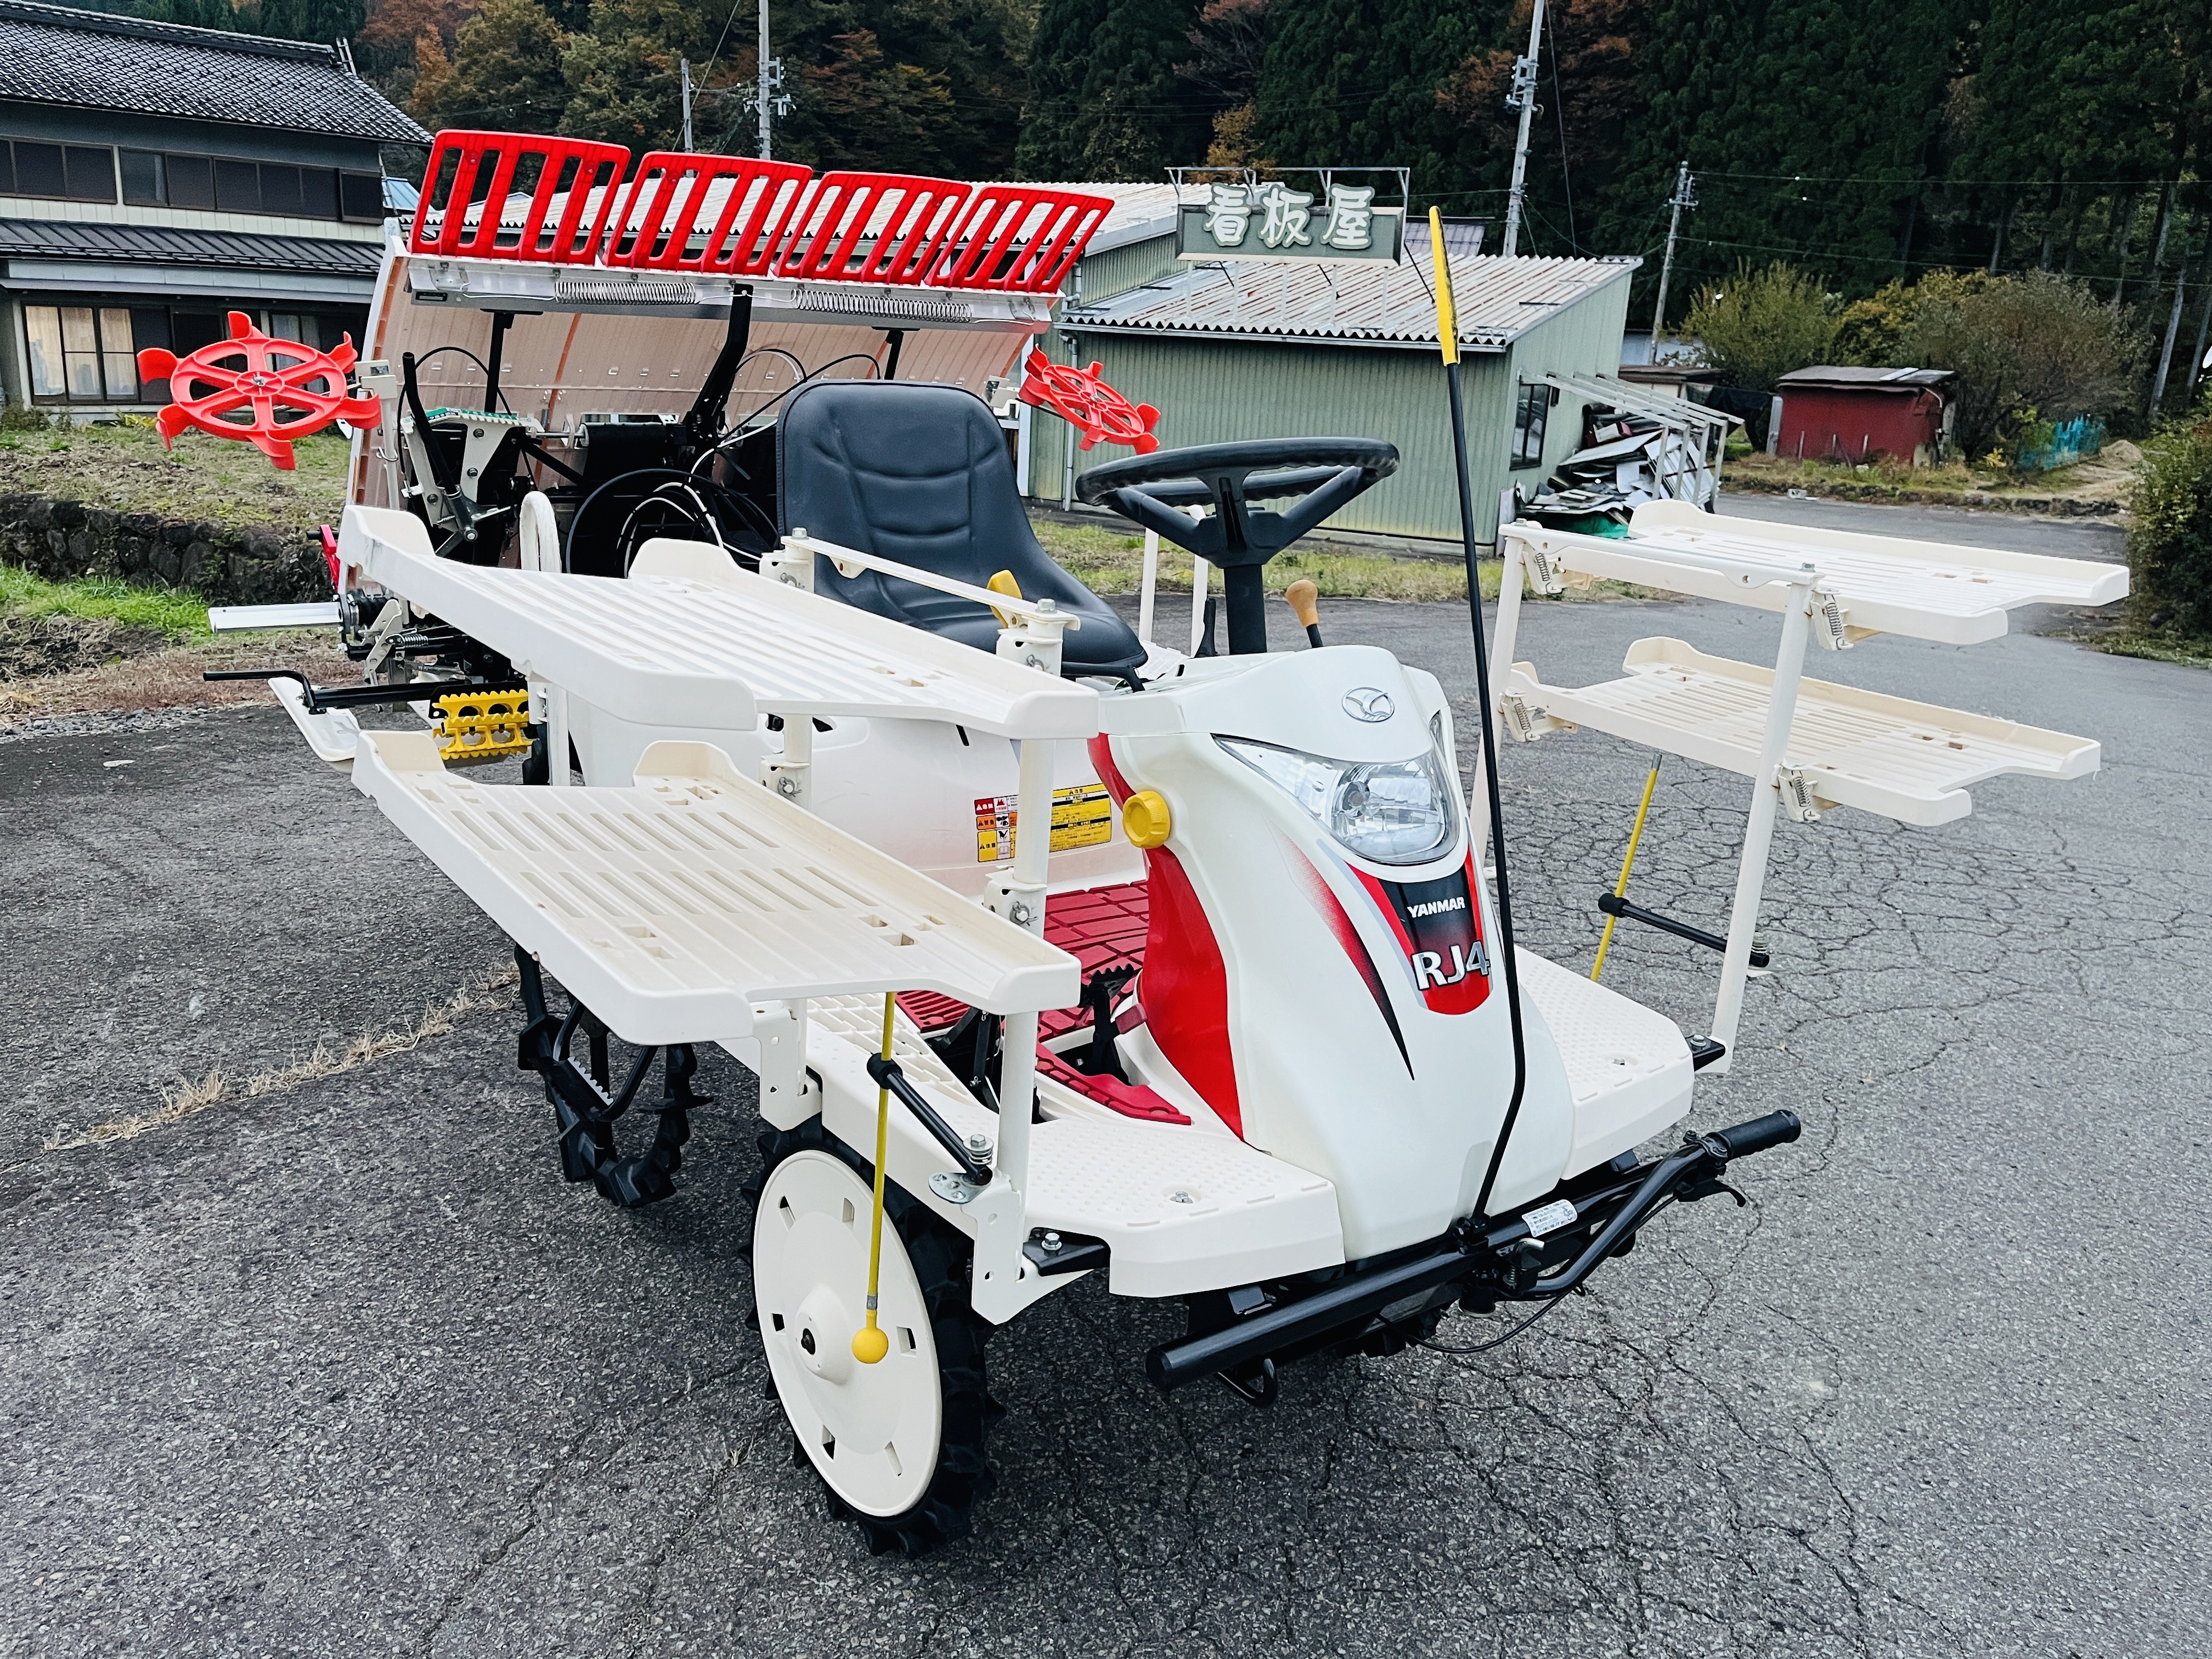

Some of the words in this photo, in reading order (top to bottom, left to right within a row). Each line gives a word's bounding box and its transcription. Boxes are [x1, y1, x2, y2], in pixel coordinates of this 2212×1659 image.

[1205, 184, 1373, 247] 看板屋
[1407, 896, 1465, 918] YANMAR
[1412, 941, 1490, 990] RJ4
